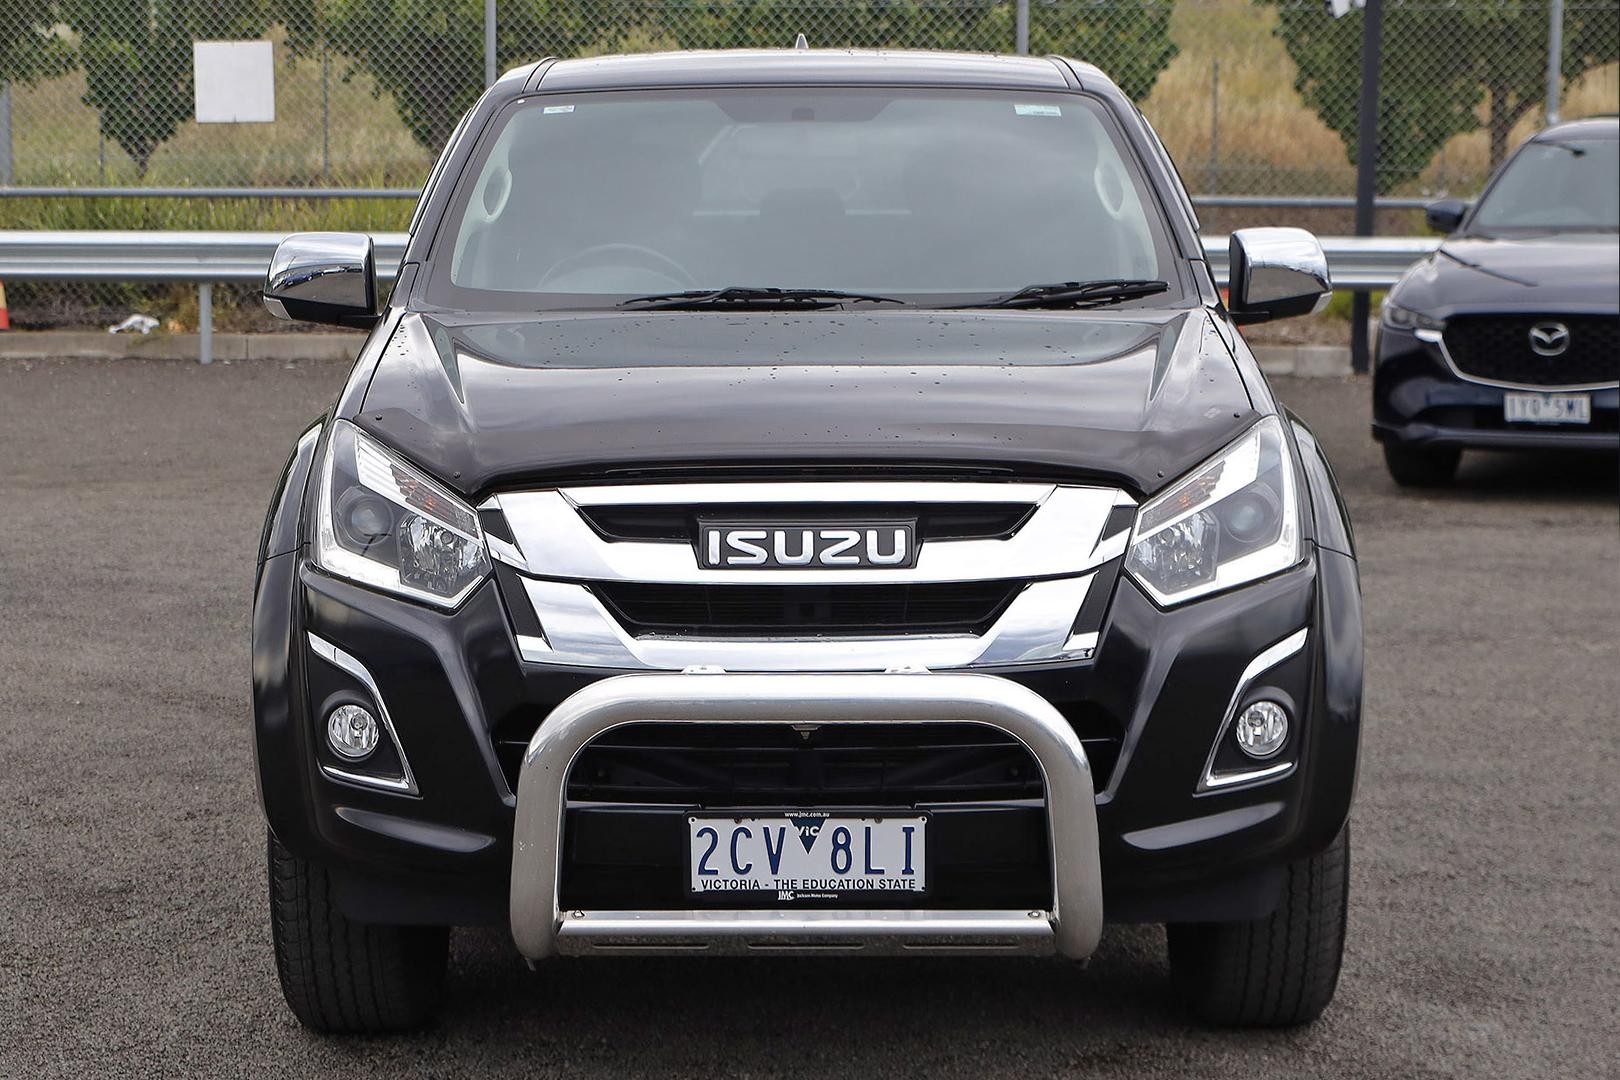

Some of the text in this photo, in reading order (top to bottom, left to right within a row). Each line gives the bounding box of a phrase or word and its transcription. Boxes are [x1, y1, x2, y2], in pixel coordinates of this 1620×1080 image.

[708, 529, 906, 565] ISUZU
[696, 826, 915, 876] 2CV 8LI
[700, 879, 761, 890] VICTORIA
[773, 879, 798, 890] THE
[802, 879, 874, 890] EDUCATION
[878, 878, 916, 890] STATE
